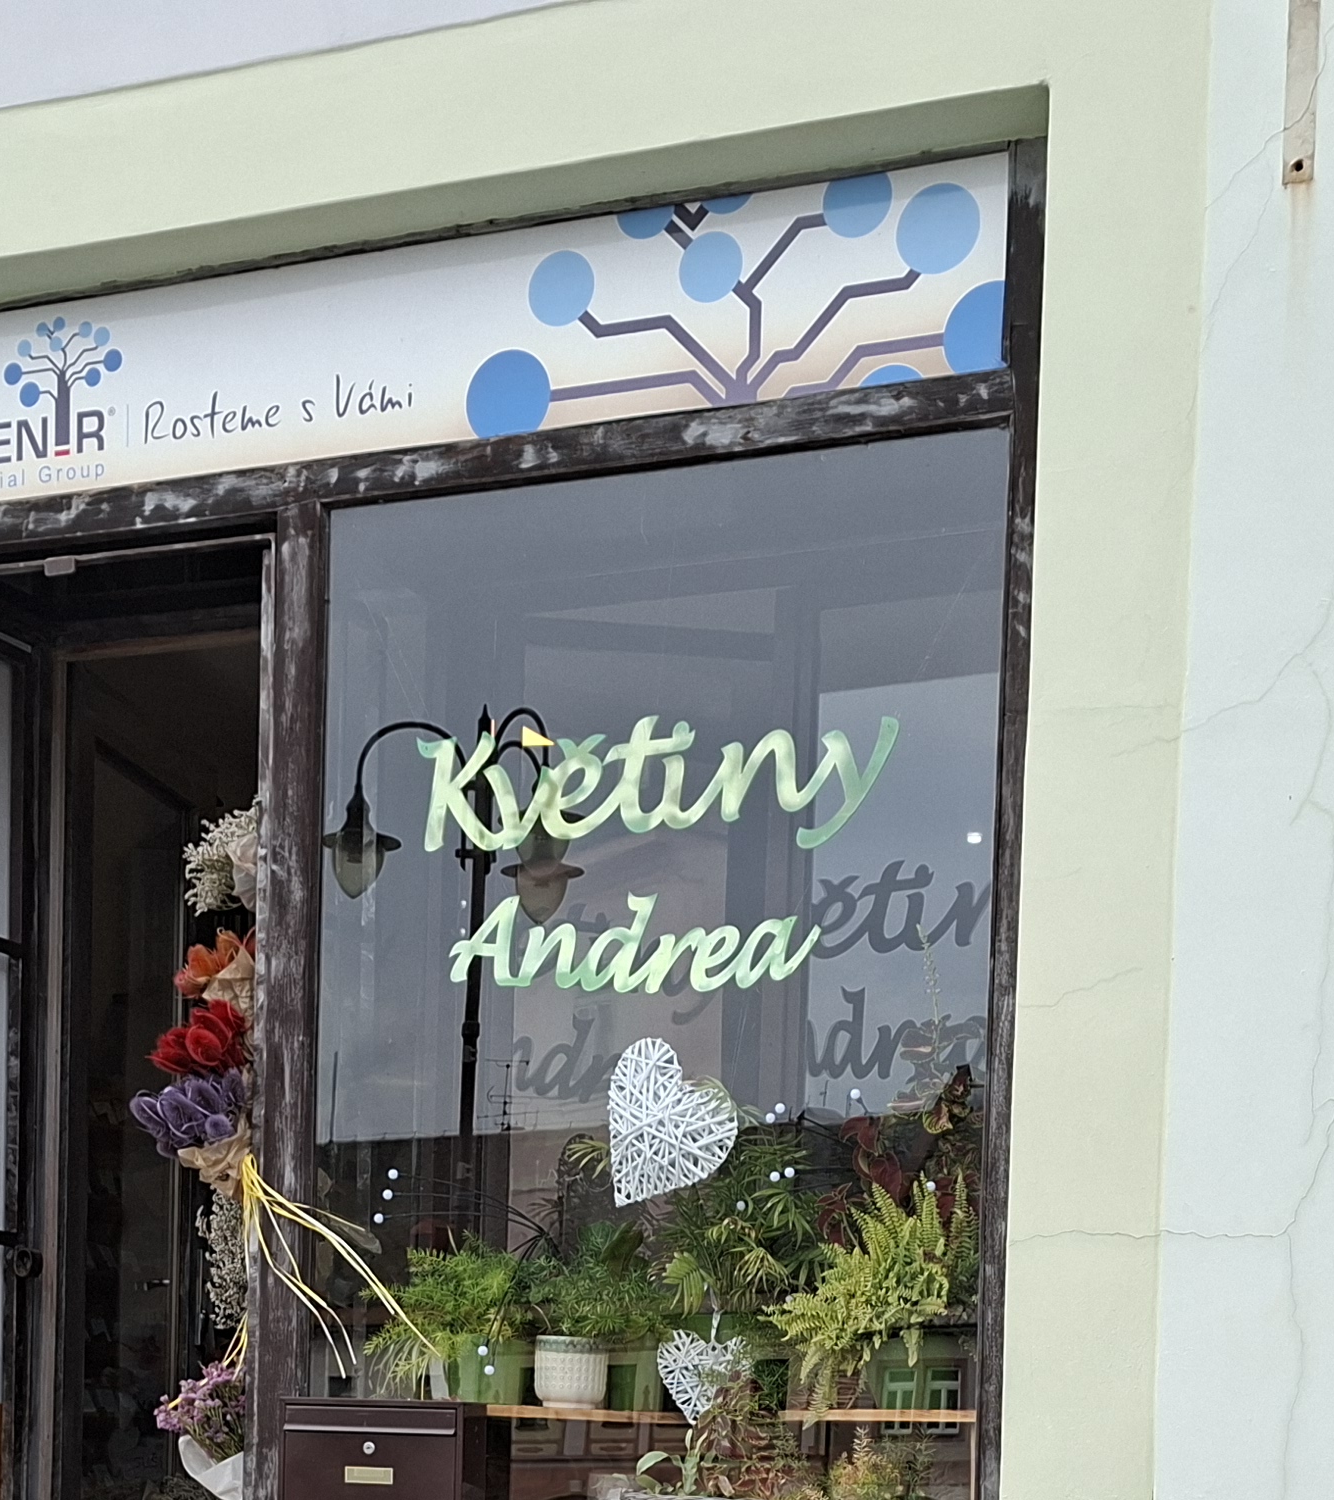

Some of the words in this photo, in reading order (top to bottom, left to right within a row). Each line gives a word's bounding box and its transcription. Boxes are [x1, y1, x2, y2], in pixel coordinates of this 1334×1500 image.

[144, 390, 282, 445] Rosteme
[301, 399, 316, 423] s
[335, 373, 413, 418] Vámi
[38, 462, 105, 484] Group
[417, 714, 901, 852] Květiny
[449, 891, 822, 994] Andrea
